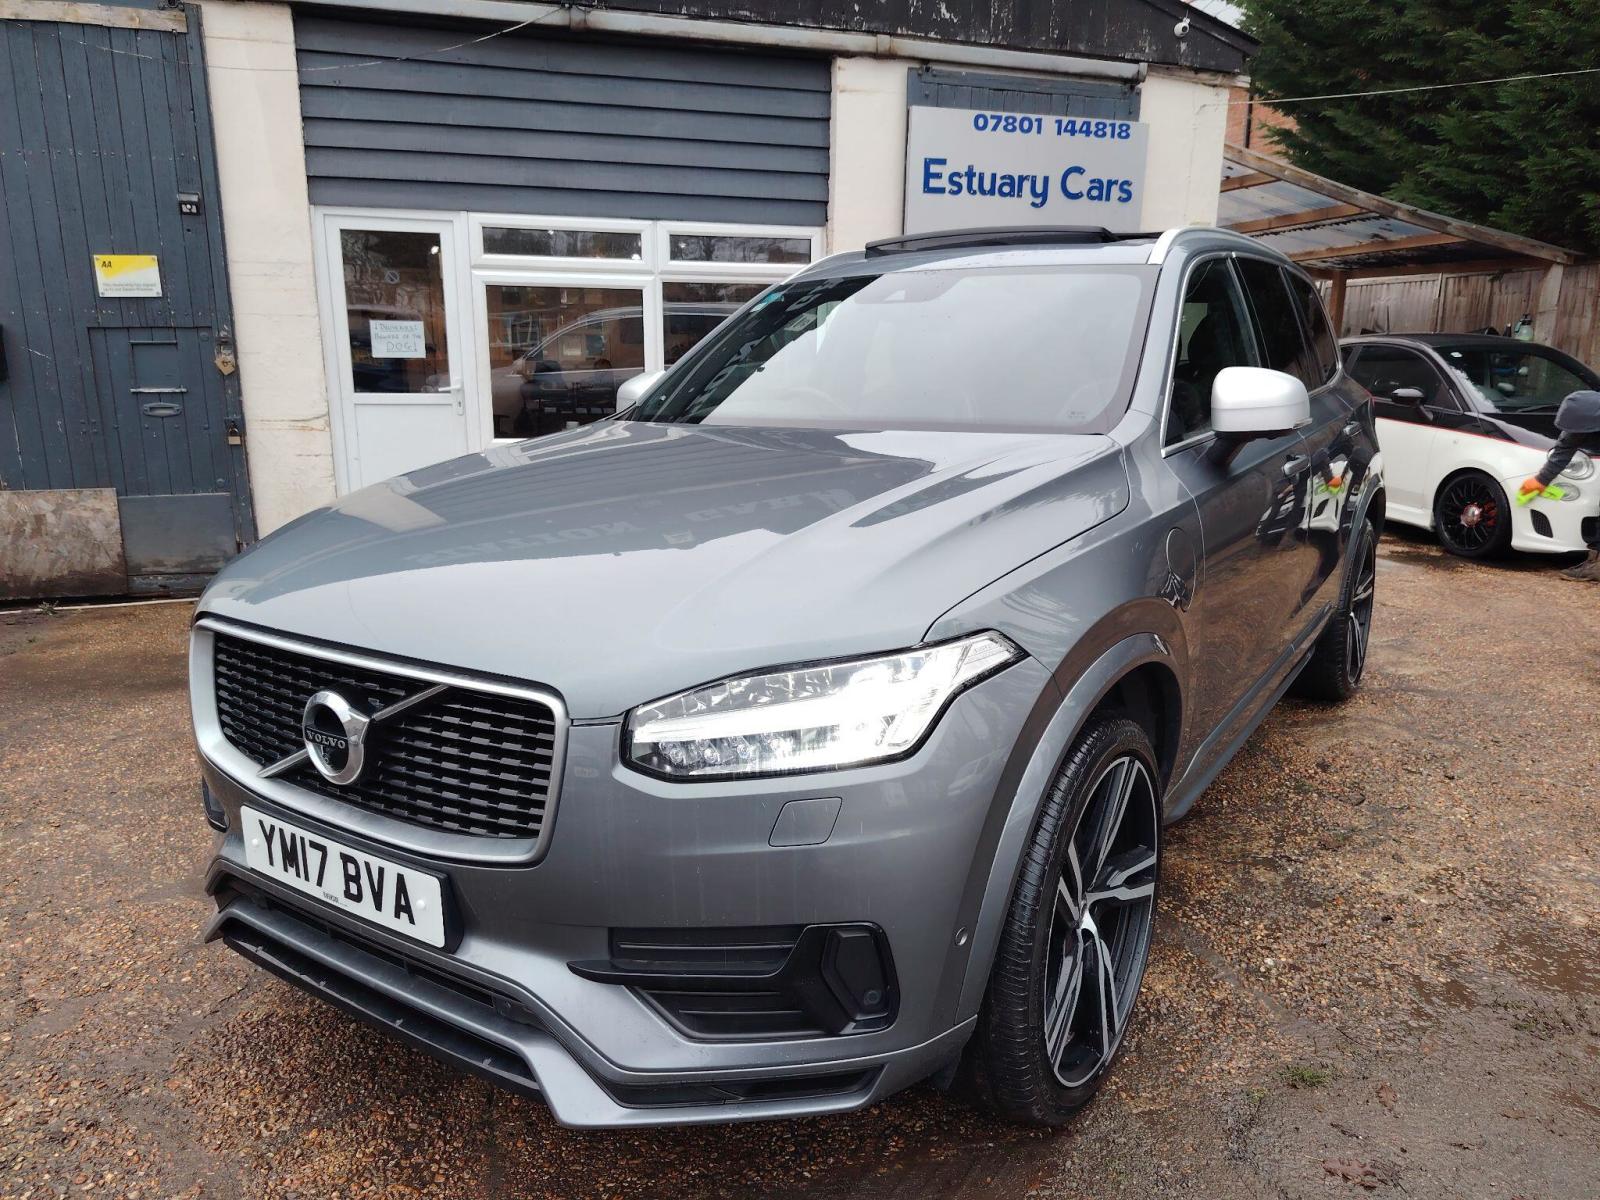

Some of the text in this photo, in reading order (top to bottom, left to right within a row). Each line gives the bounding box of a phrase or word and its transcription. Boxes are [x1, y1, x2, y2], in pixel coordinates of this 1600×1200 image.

[973, 113, 1131, 140] 07801 144818
[922, 157, 1134, 209] Estuary Cars
[101, 260, 113, 269] AA
[306, 729, 346, 749] VOLVO
[258, 819, 416, 926] YM17 BVA
